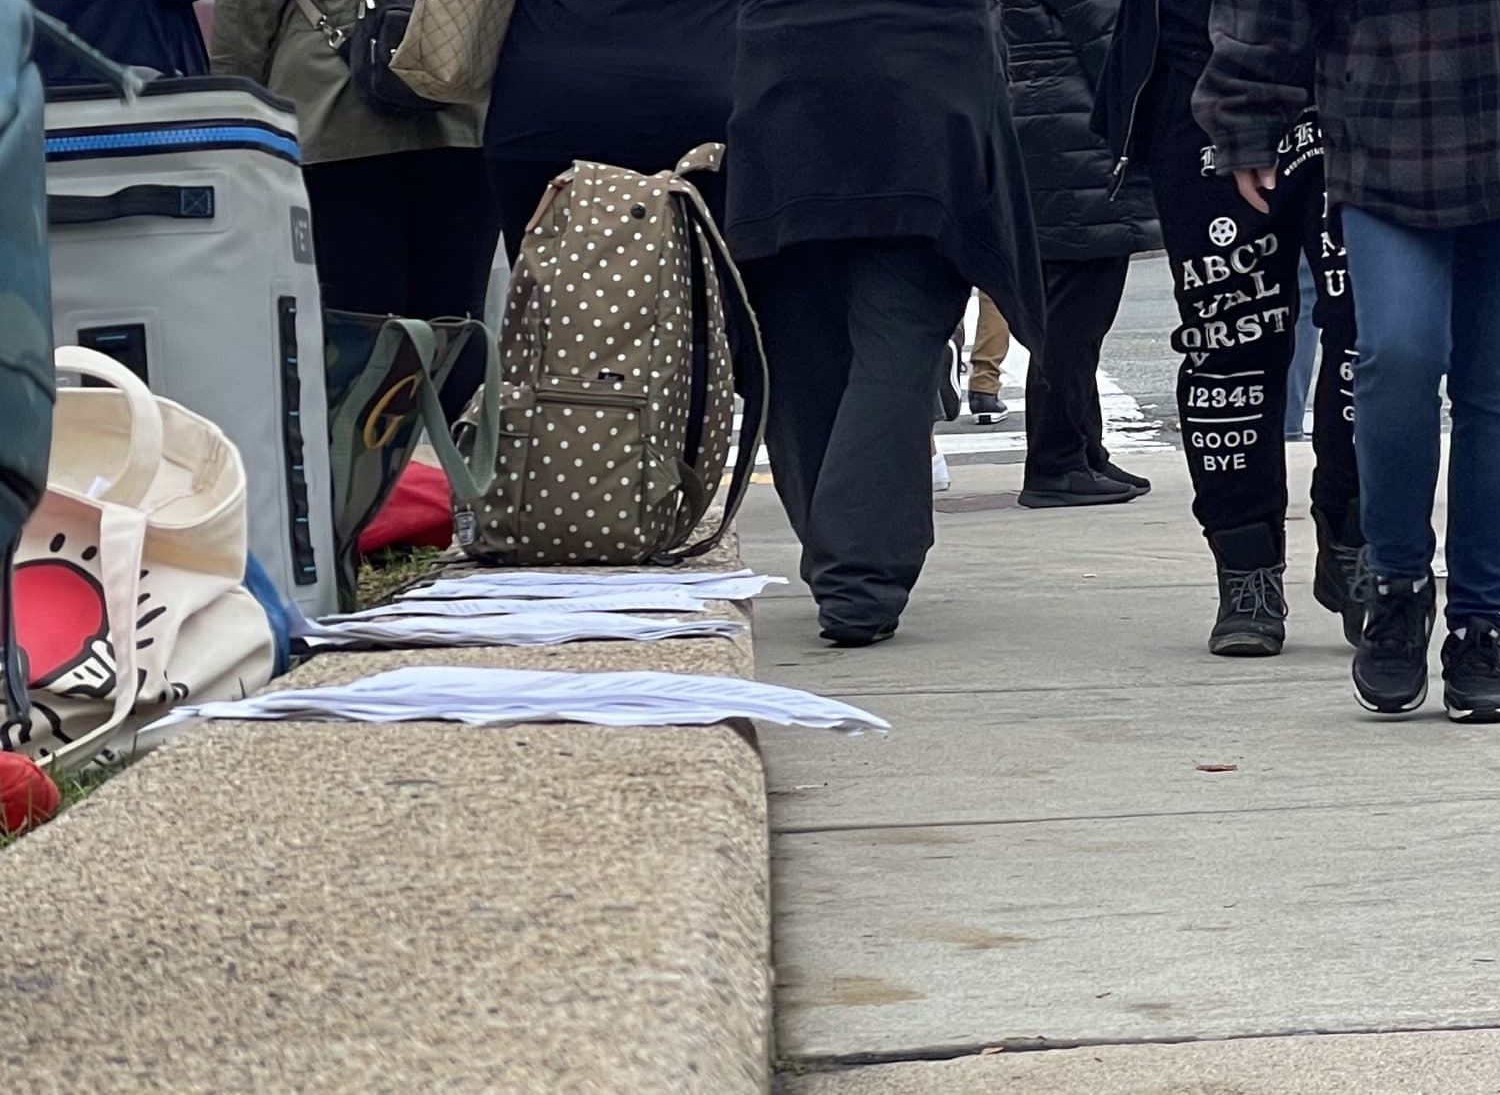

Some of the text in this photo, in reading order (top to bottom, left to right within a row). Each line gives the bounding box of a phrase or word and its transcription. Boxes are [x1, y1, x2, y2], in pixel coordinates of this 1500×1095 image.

[1187, 385, 1265, 408] 12345
[1191, 429, 1258, 448] GOOD
[1203, 453, 1247, 472] BYE
